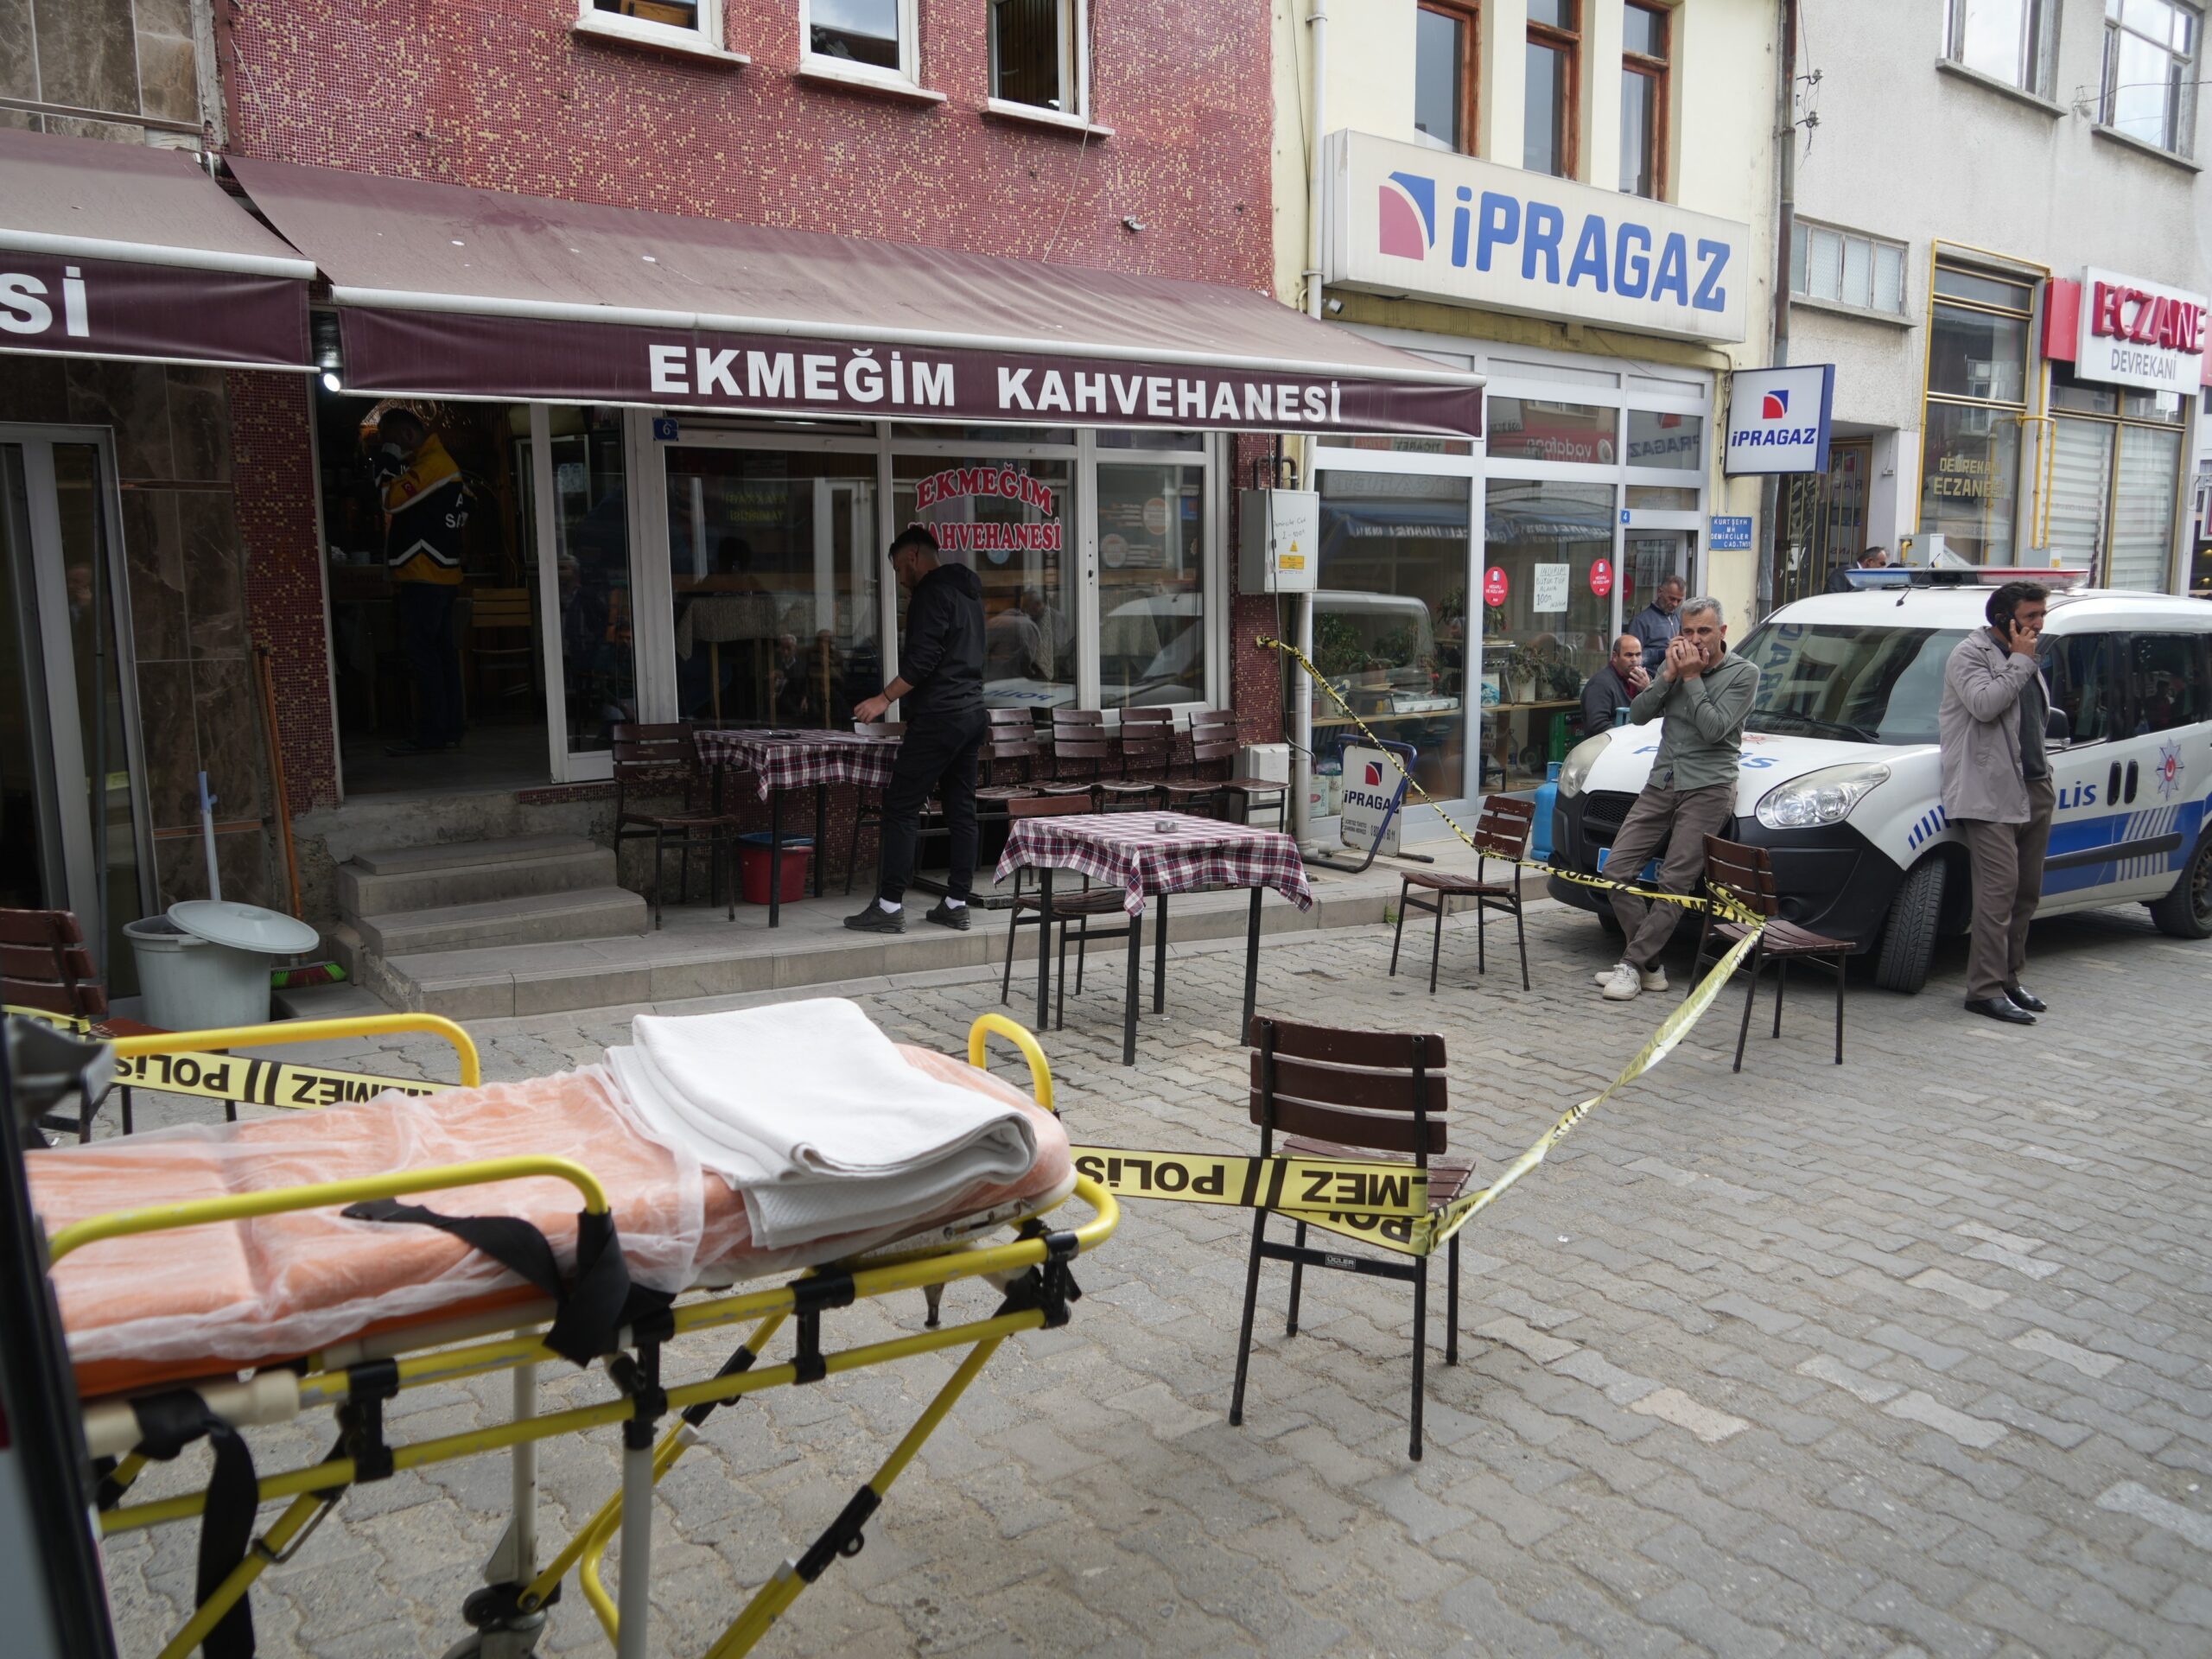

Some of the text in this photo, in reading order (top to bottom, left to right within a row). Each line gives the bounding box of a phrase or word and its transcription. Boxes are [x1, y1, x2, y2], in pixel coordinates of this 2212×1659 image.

[2091, 281, 2207, 355] ECZANE
[649, 345, 1341, 423] EKMEĞİM KAHVEHANESİ
[2111, 349, 2177, 380] DEVREKANİ
[916, 462, 1052, 516] EKMEĞİM
[908, 518, 1062, 552] AHVEHANESİ
[2058, 780, 2096, 810] LİS
